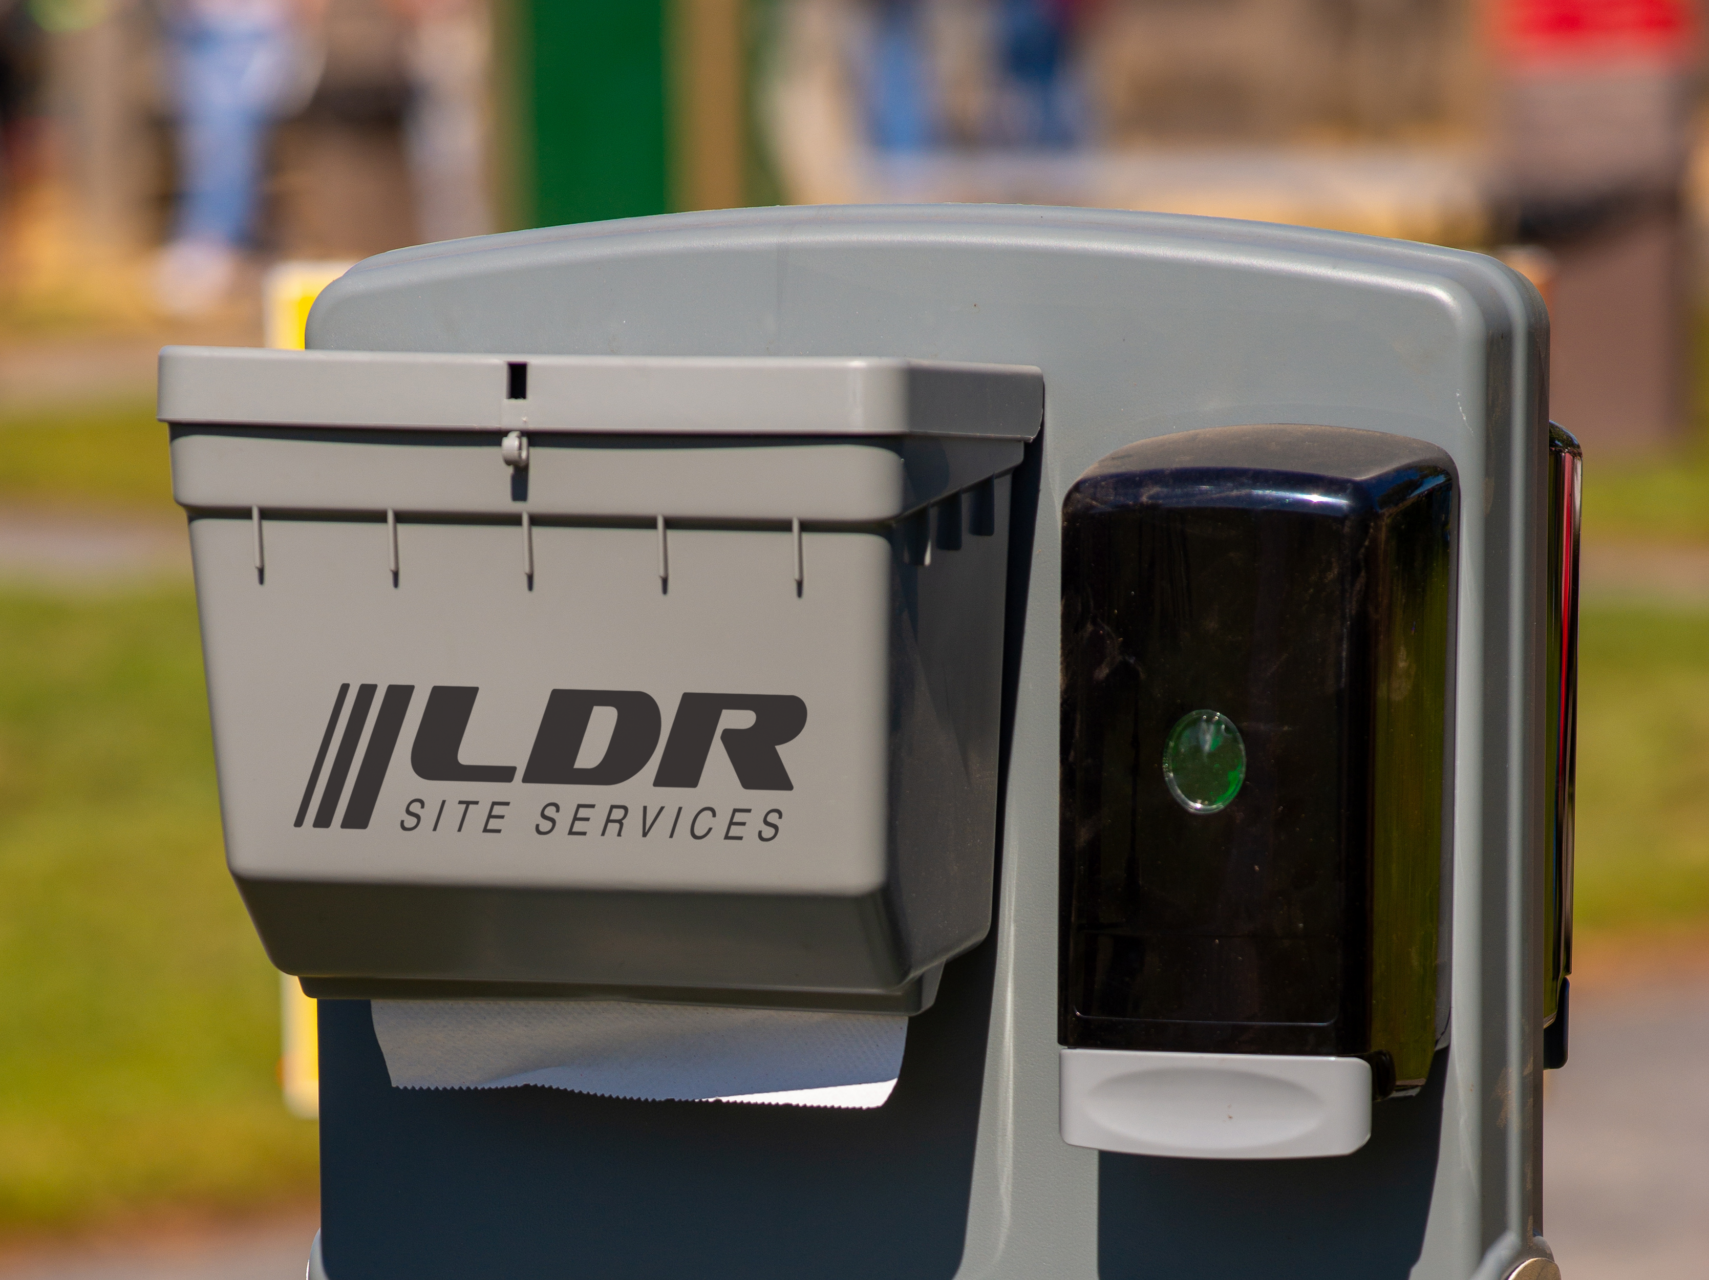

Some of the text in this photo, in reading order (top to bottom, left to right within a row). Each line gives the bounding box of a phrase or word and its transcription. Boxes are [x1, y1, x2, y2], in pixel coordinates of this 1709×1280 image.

[411, 685, 808, 791] LDR
[400, 798, 784, 842] SITE SERVICES
